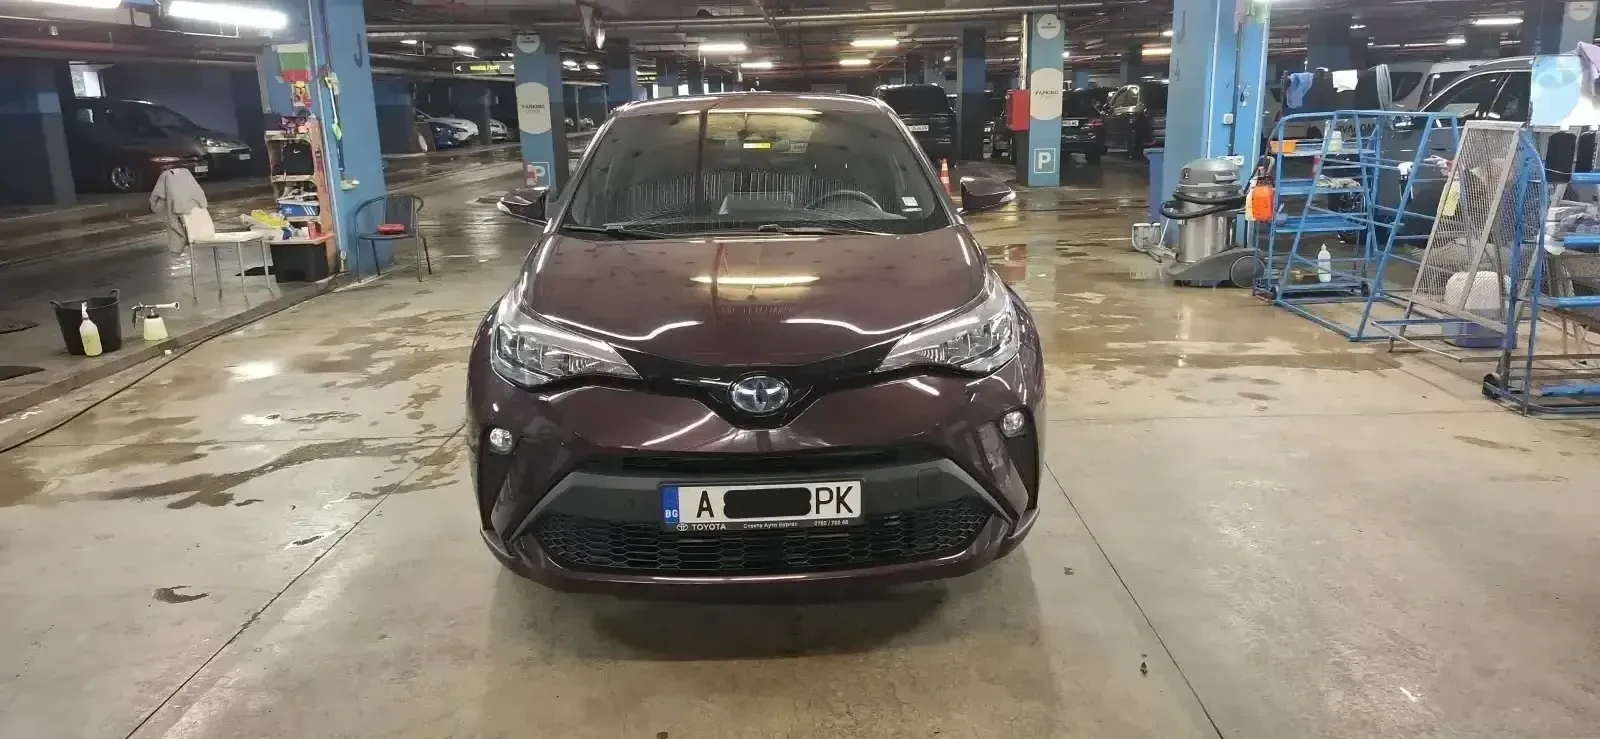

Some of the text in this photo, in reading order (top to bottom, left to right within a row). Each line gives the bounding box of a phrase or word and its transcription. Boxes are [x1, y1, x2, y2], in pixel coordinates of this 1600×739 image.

[1038, 152, 1051, 170] P
[696, 485, 854, 518] A PK
[664, 509, 679, 518] BG
[691, 523, 727, 531] TOYOTA
